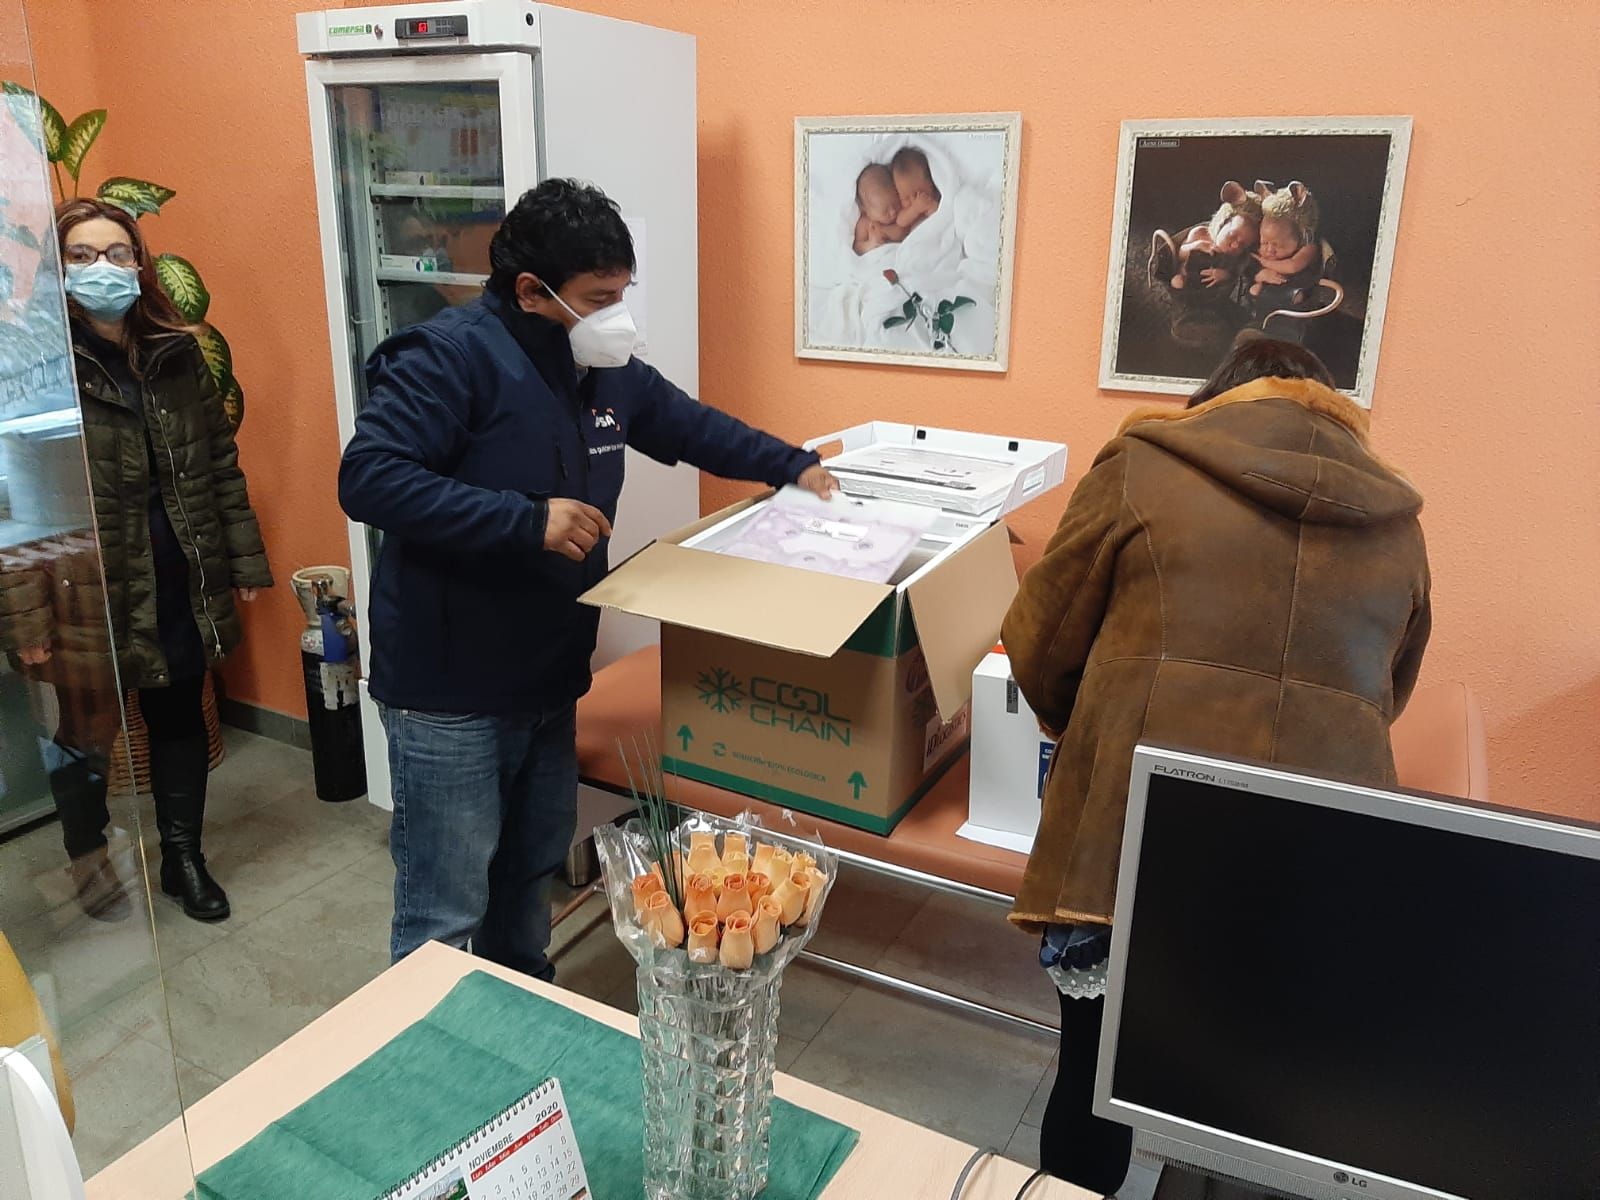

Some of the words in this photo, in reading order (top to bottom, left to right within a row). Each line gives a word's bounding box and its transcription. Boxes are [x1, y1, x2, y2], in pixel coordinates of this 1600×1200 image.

[751, 677, 851, 723] COOL
[750, 703, 851, 746] CHAIN
[1154, 764, 1216, 782] FLATRON
[469, 1132, 514, 1171] NOVIEMBRE
[535, 1101, 558, 1122] 2020
[495, 1184, 501, 1194] 3
[521, 1165, 528, 1174] 5
[535, 1154, 541, 1164] 6
[548, 1144, 553, 1155] 7
[512, 1187, 520, 1199] 11
[524, 1176, 534, 1189] 12
[537, 1167, 547, 1179] 13
[550, 1157, 559, 1170] 14
[563, 1148, 573, 1160] 15
[541, 1180, 551, 1194] 20
[554, 1171, 563, 1184] 21
[567, 1160, 576, 1174] 22
[557, 1183, 567, 1196] 28
[570, 1174, 580, 1187] 29
[1352, 1177, 1367, 1188] LG
